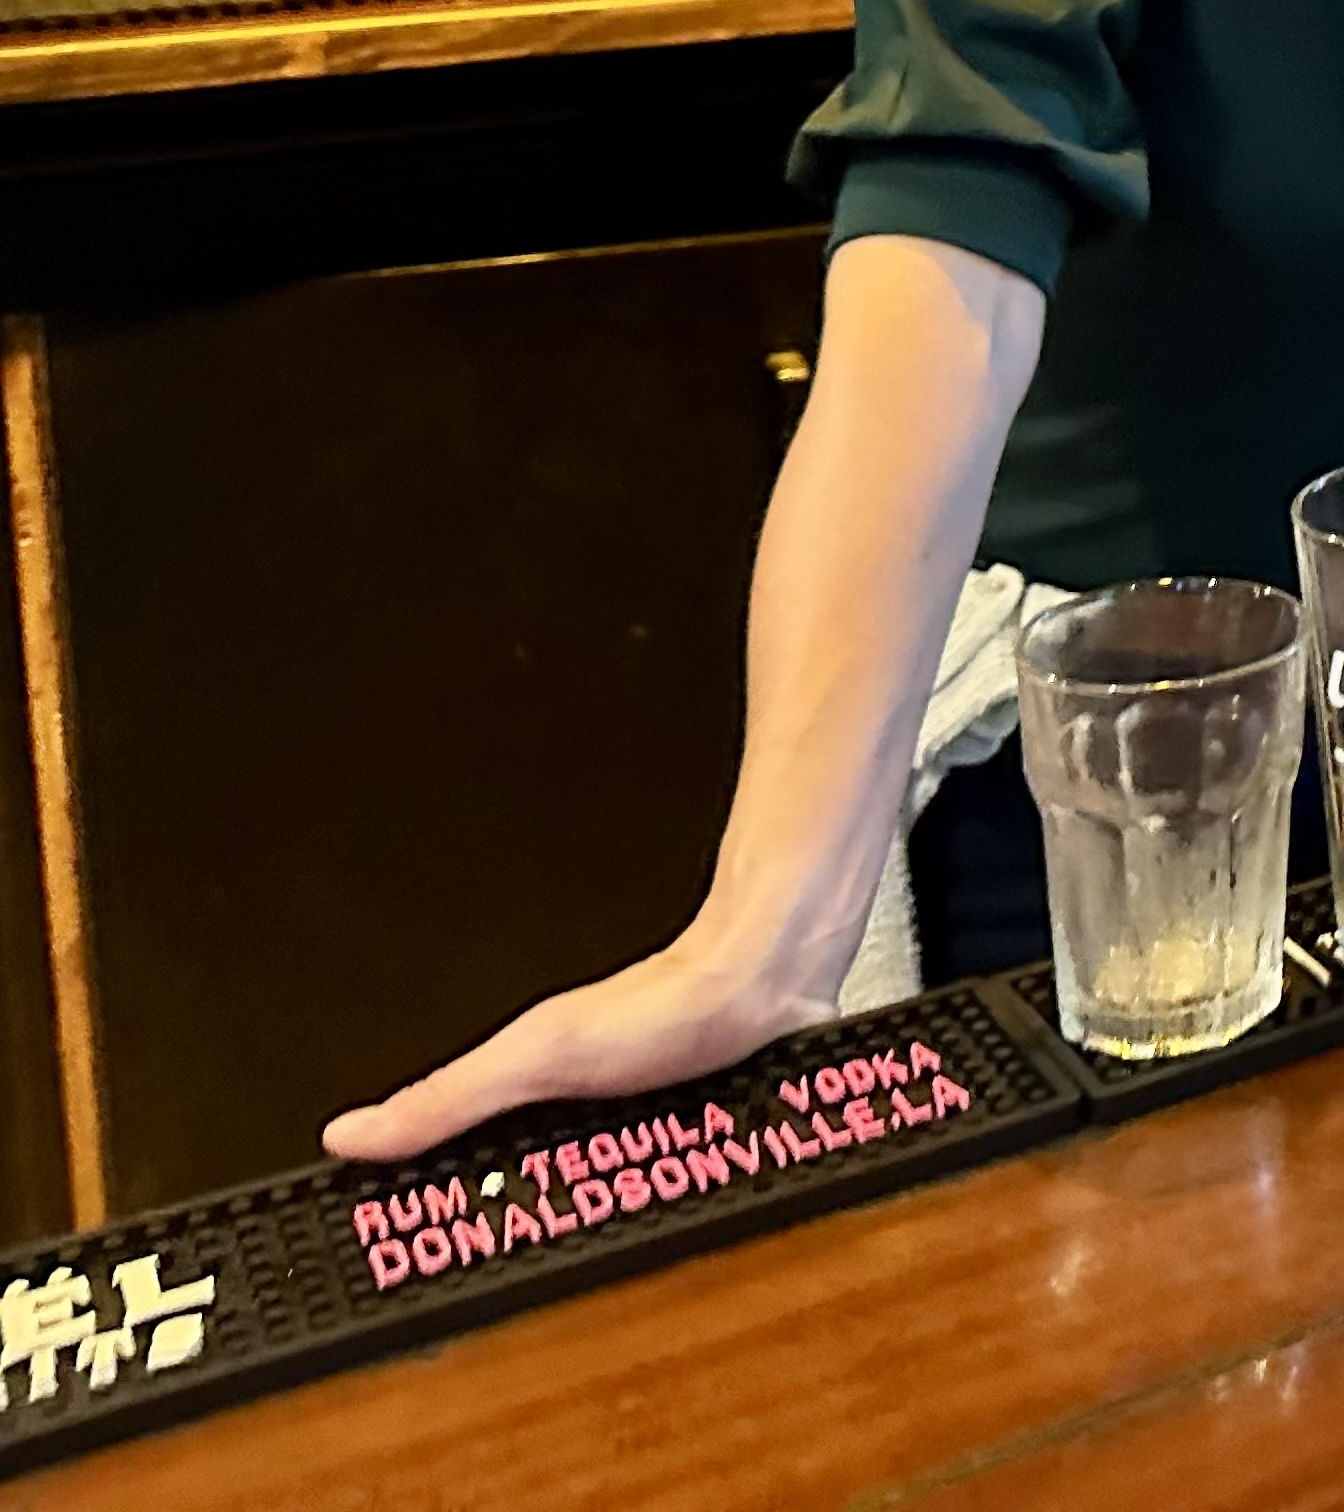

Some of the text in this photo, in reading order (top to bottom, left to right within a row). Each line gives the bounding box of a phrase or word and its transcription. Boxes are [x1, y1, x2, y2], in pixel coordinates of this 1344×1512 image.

[353, 1041, 942, 1247] RUM TEQUILA VODKA
